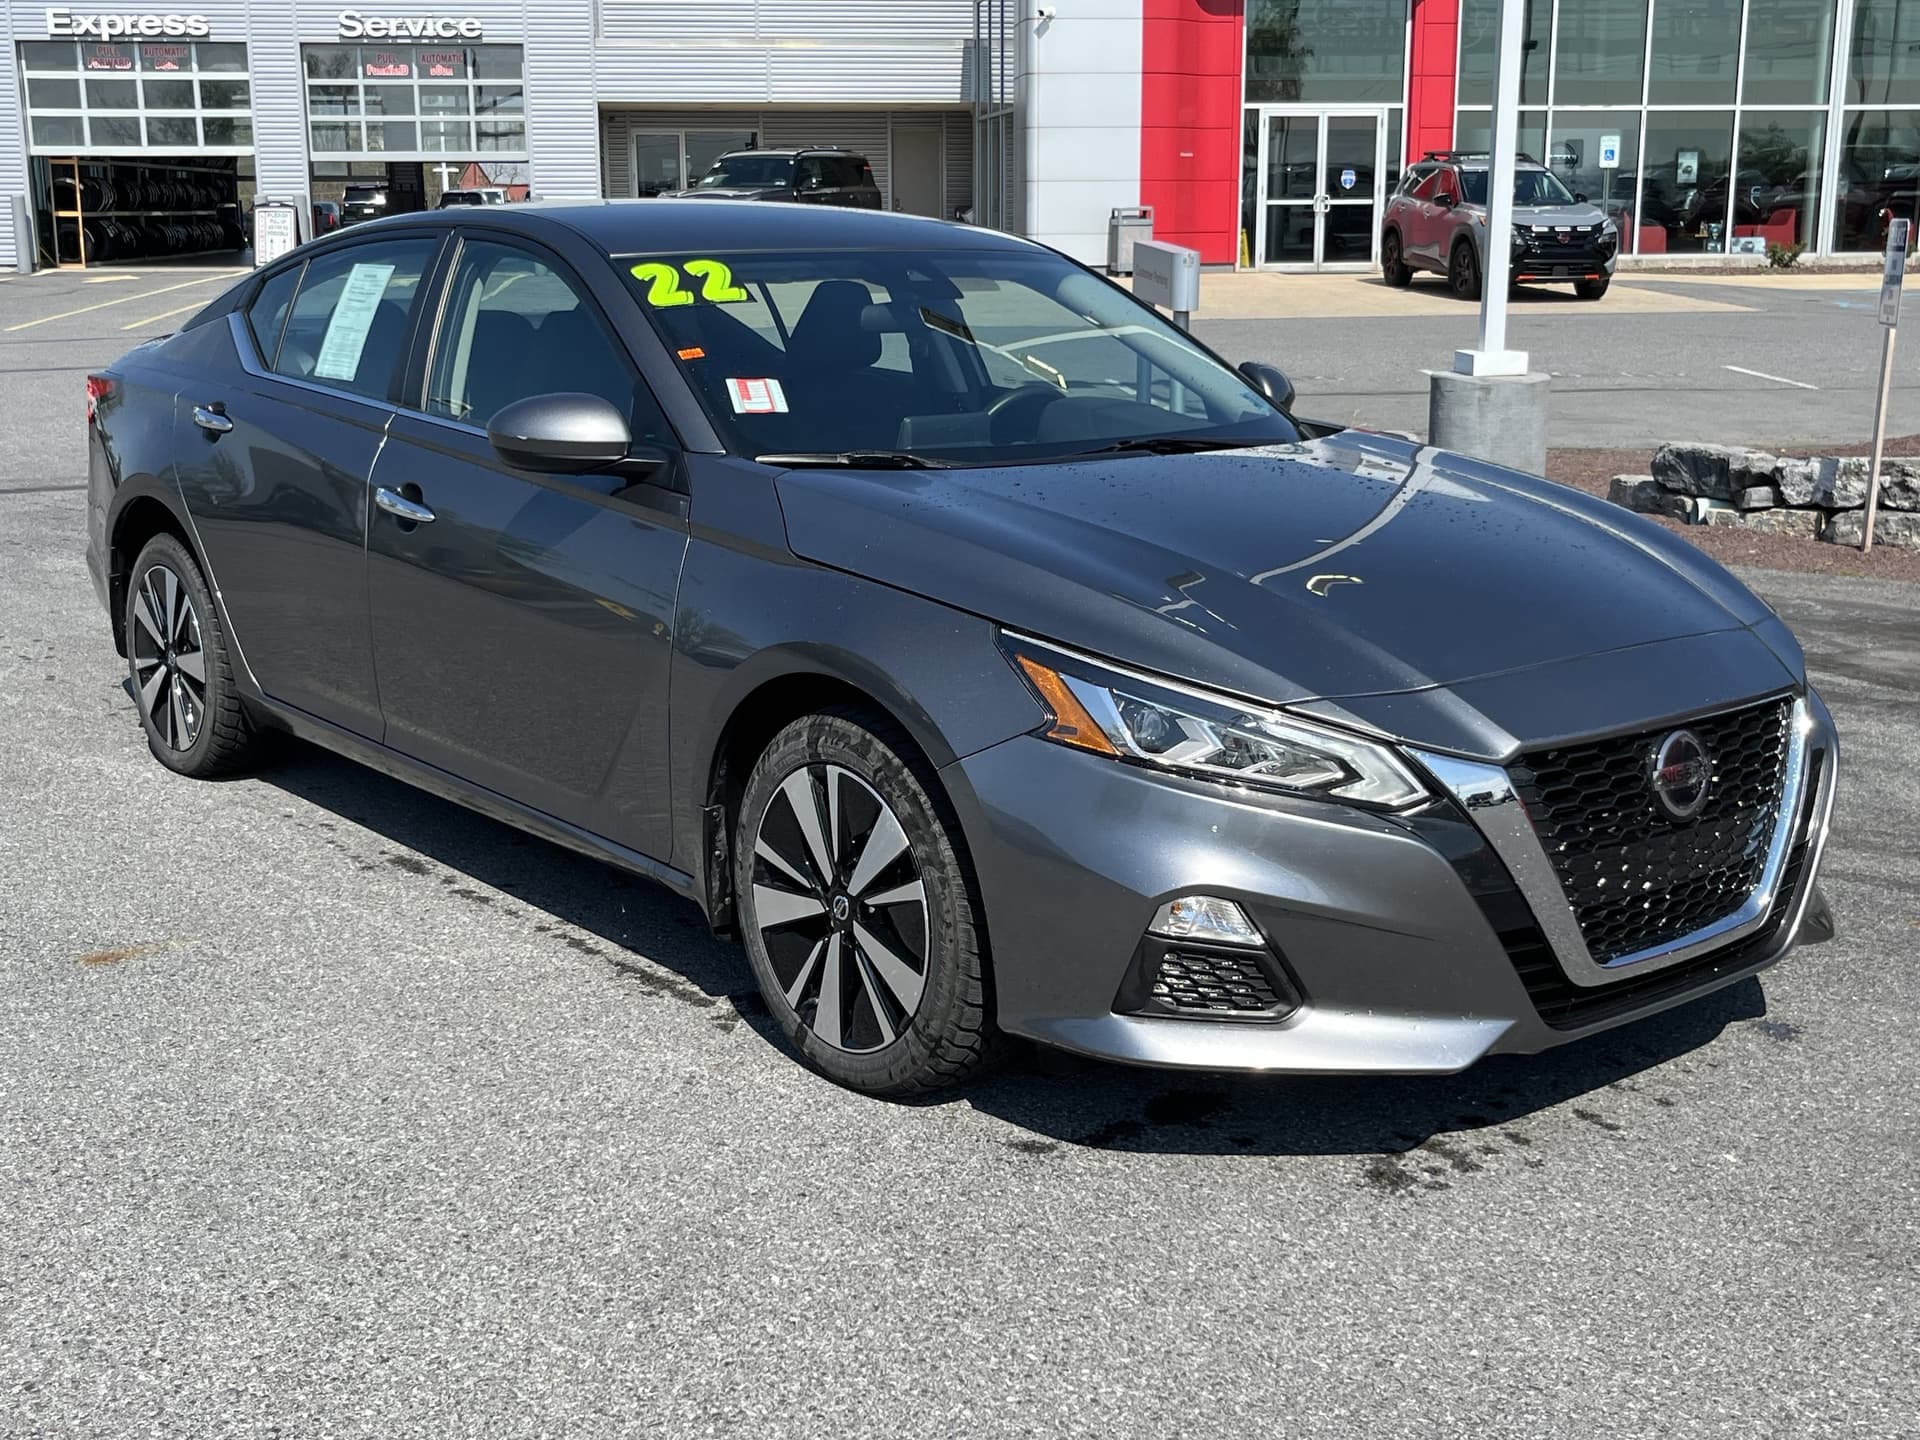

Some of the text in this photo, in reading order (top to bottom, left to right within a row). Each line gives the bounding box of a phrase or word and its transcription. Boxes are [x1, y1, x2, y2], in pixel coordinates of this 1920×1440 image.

[45, 7, 483, 42] Express Service
[96, 46, 120, 57] PULL
[143, 47, 188, 57] AUTOMATIC
[88, 57, 132, 69] FORWARD
[376, 53, 398, 64] PULL
[421, 53, 464, 64] AUTOMATIC
[366, 64, 409, 76] FORWARD
[630, 260, 748, 307] 22
